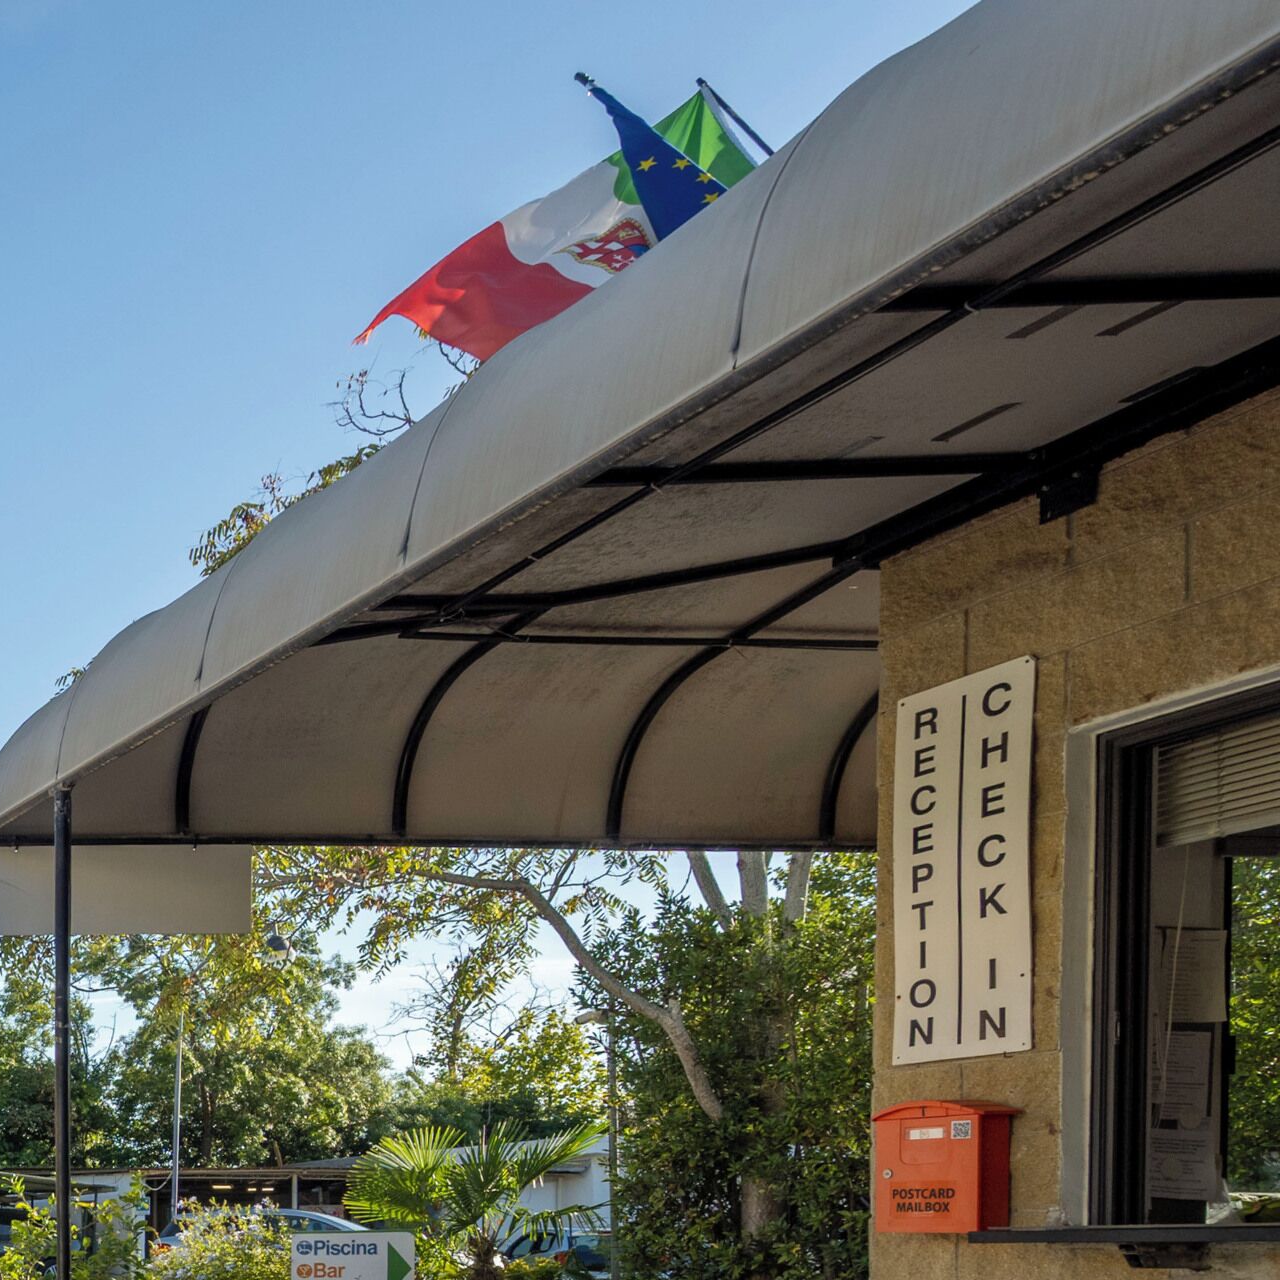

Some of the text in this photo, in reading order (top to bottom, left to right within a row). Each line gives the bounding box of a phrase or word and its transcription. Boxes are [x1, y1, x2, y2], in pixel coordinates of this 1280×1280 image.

[976, 681, 1013, 1041] CHECK IN
[908, 706, 939, 1048] RECEPTION
[892, 1188, 955, 1199] POSTCARD
[896, 1202, 951, 1213] MAILBOX
[313, 1239, 378, 1256] Piscina
[313, 1262, 346, 1278] Bar
